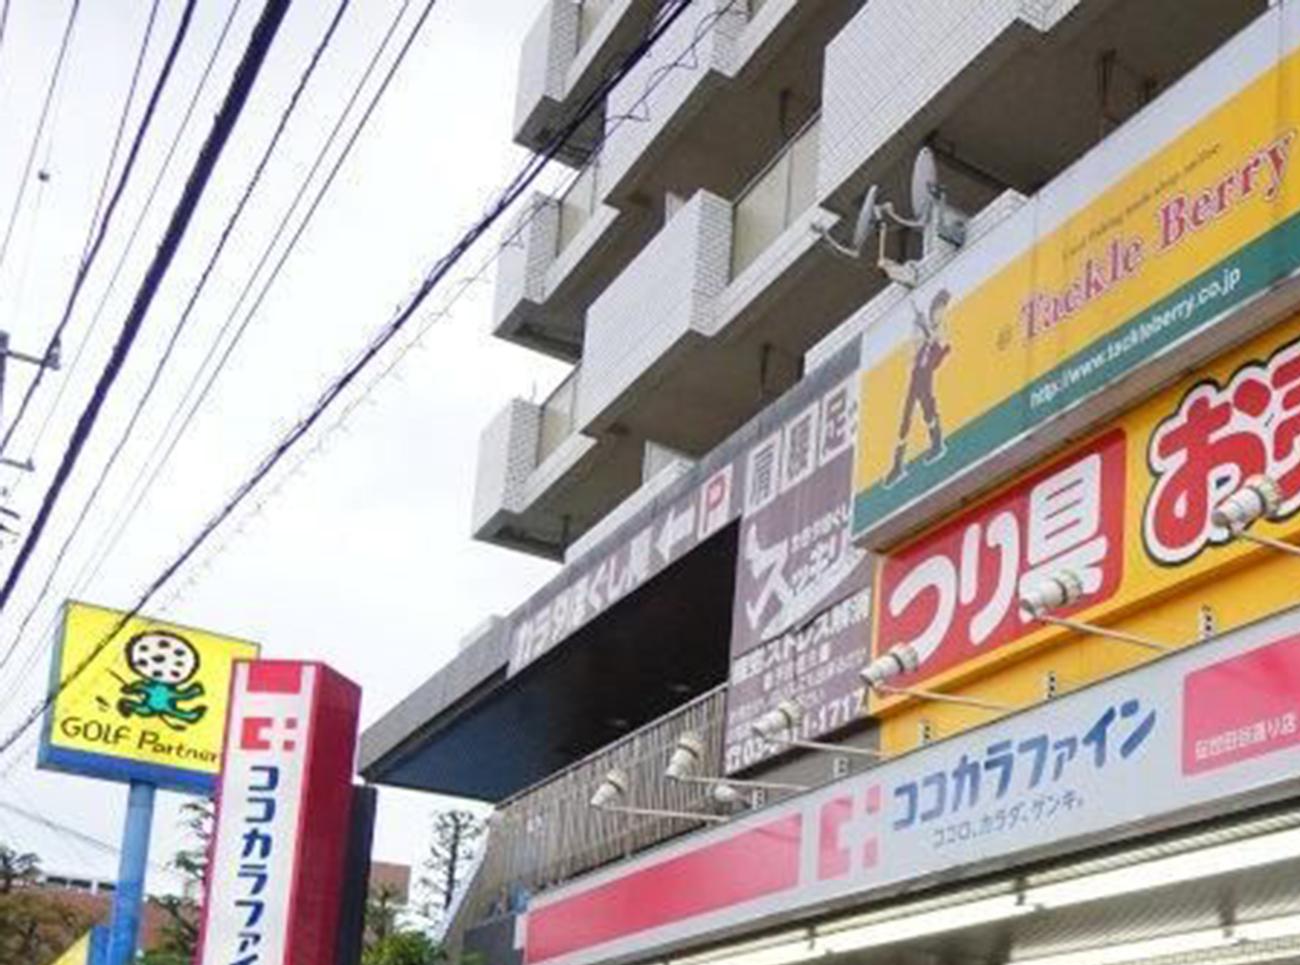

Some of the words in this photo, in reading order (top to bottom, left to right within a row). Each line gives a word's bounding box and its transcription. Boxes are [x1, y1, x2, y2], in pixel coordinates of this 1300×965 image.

[1020, 237, 1144, 340] Tackle
[1152, 128, 1298, 256] Berry
[1028, 266, 1243, 408] http://www.tackleberry.co.jp
[703, 475, 726, 533] P
[889, 452, 1109, 667] つり具
[60, 716, 131, 744] GOLF
[137, 730, 218, 763] Partner
[892, 698, 1156, 831] ココカラファイン
